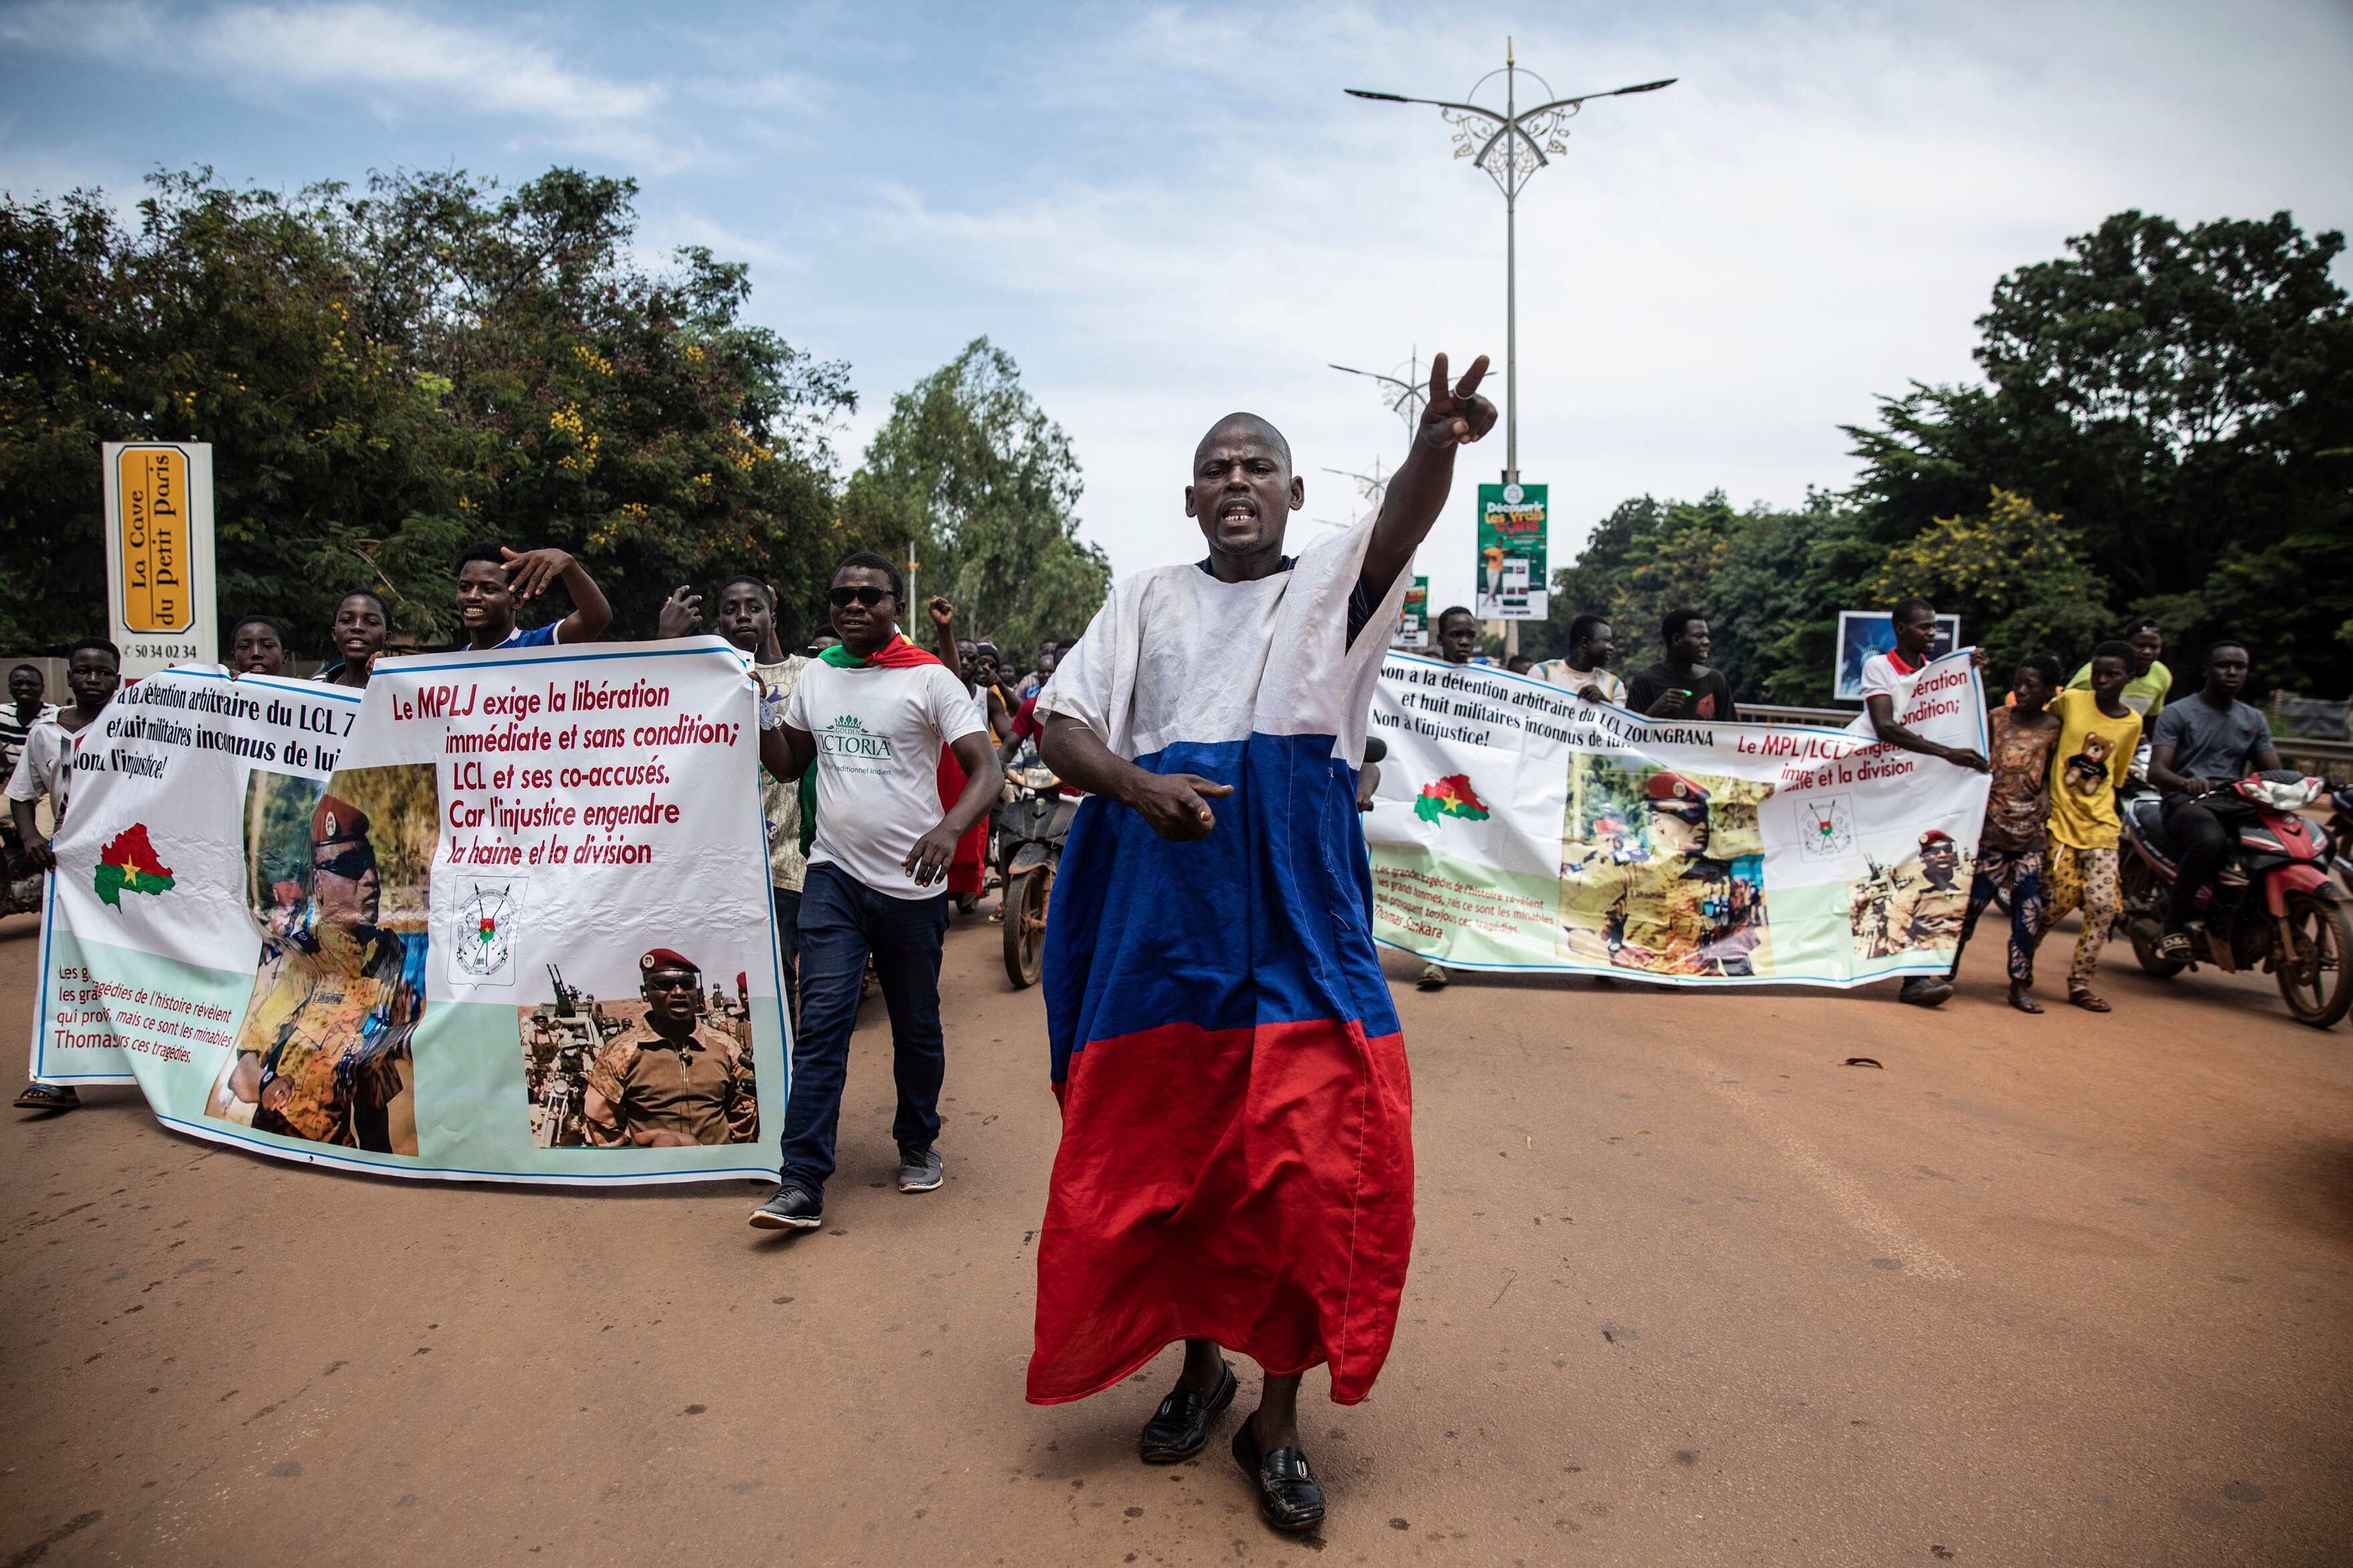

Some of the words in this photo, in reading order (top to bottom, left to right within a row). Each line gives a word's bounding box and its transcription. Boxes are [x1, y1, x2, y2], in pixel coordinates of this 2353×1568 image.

[131, 491, 145, 548] Cave
[132, 560, 146, 589] La
[156, 599, 174, 625] du
[135, 645, 147, 657] 50
[150, 645, 162, 658] 34
[165, 645, 179, 658] 02
[183, 645, 196, 658] 34
[129, 684, 139, 704] la
[188, 686, 260, 720] arbitraire
[267, 700, 292, 727] du
[299, 704, 337, 736] LCL
[392, 694, 413, 721] Le
[418, 684, 477, 719] MPLJ
[483, 686, 541, 721] exige
[548, 682, 566, 712] la
[572, 678, 670, 711] libération
[1409, 667, 1418, 683] à
[1424, 670, 1436, 686] la
[1442, 672, 1508, 701] détention
[1512, 688, 1575, 720] arbitraire
[1579, 707, 1596, 722] du
[1600, 713, 1620, 736] LCL
[1624, 723, 1714, 747] ZOUNGRANA
[445, 722, 552, 754] immédiate
[558, 724, 577, 749] et
[583, 727, 625, 749] sans
[633, 713, 740, 747] condition;
[1372, 709, 1399, 728] Non
[1404, 714, 1412, 731] à
[1416, 717, 1490, 747] l'injustice!
[1401, 692, 1416, 708] et
[1420, 693, 1450, 714] huit
[1454, 702, 1521, 729] militaires
[1525, 716, 1584, 746] inconnus
[1589, 730, 1602, 747] de
[106, 717, 121, 738] et
[146, 718, 192, 747] militaires
[197, 723, 276, 761] inconnus
[283, 740, 308, 767] de
[1737, 735, 1756, 754] Le
[111, 749, 167, 779] l'injustice!
[454, 762, 486, 790] LCL
[494, 764, 514, 789] et
[521, 769, 552, 789] ses
[560, 755, 670, 788] co-accusés.
[870, 767, 891, 775] Indien
[1819, 769, 1833, 787] et
[1838, 764, 1851, 784] la
[1857, 758, 1913, 781] division
[449, 799, 485, 828] Car
[490, 796, 576, 835] l'injustice
[583, 793, 680, 833] engendre
[446, 836, 467, 864] la
[469, 835, 522, 865] haine
[529, 840, 545, 865] et
[548, 834, 568, 864] la
[573, 834, 652, 865] division
[1375, 864, 1389, 874] Les
[1454, 880, 1463, 892] de
[1464, 883, 1503, 901] l'histoire
[1377, 892, 1388, 903] qui
[1377, 876, 1389, 887] les
[1462, 902, 1473, 911] ce
[1475, 904, 1495, 915] sont
[1497, 905, 1511, 917] les
[1513, 910, 1554, 924] minables
[1374, 904, 1403, 926] Thomas
[1403, 916, 1443, 939] Sankara
[59, 965, 78, 979] Les
[135, 988, 148, 1004] de
[149, 990, 192, 1014] l'histoire
[193, 1001, 232, 1024] révèlent
[57, 1008, 78, 1027] qui
[131, 1038, 150, 1053] ces
[152, 1041, 191, 1063] tragédies.
[59, 986, 76, 1001] les
[116, 1011, 141, 1026] mais
[143, 1017, 155, 1030] ce
[157, 1020, 179, 1037] sont
[180, 1022, 194, 1039] les
[193, 1028, 233, 1048] minables
